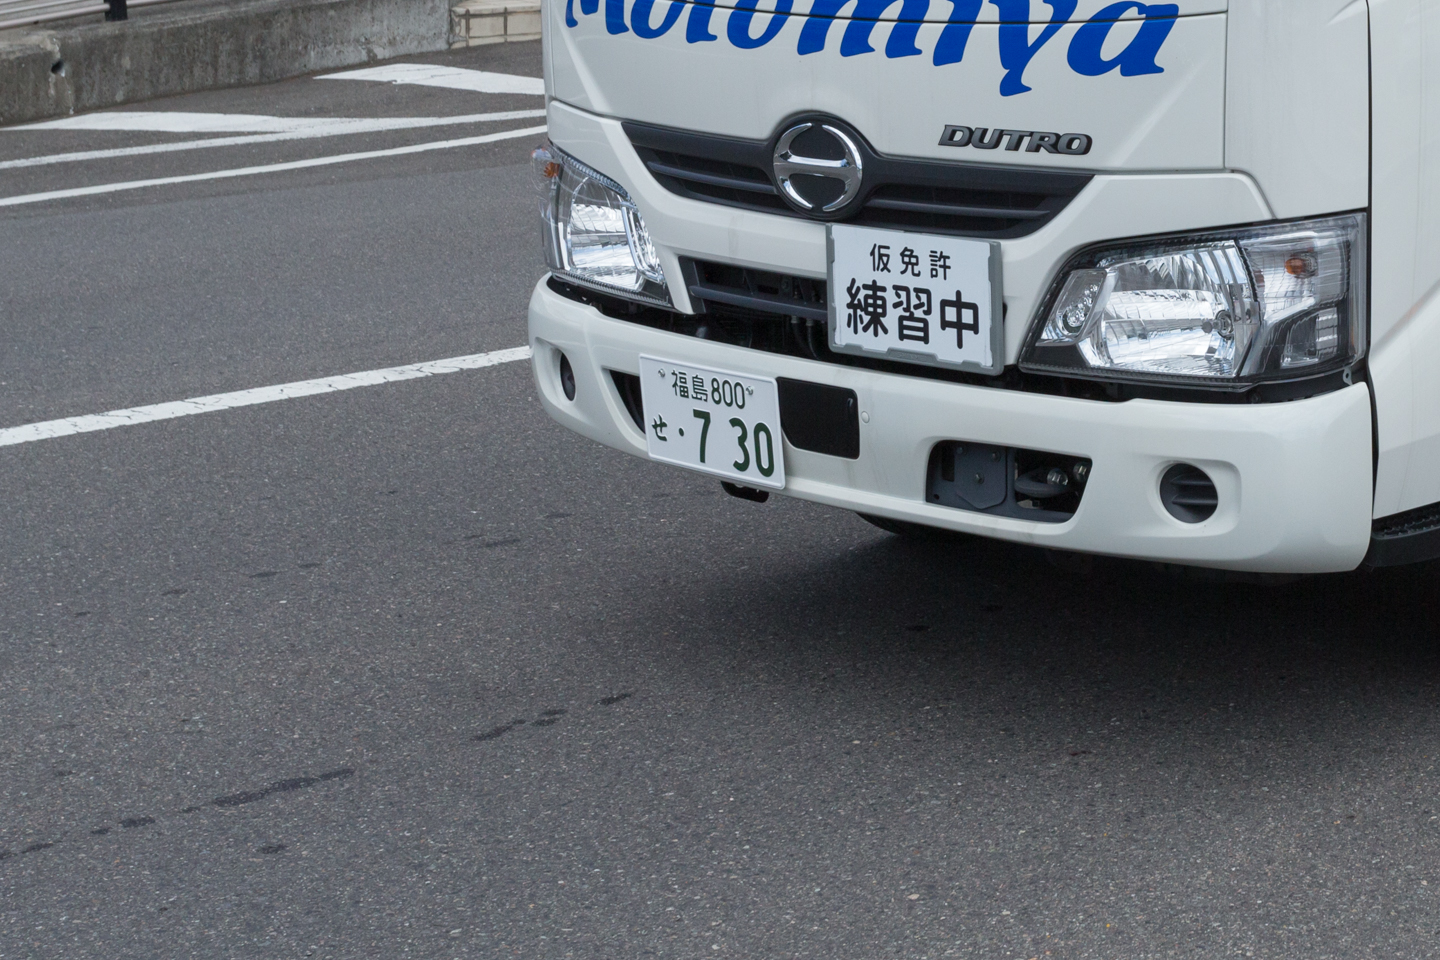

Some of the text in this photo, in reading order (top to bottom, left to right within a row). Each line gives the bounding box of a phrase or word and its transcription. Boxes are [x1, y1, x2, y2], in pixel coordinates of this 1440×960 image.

[938, 123, 1093, 156] DUTRO
[869, 243, 953, 281] 仮免許
[845, 277, 980, 350] 練習中
